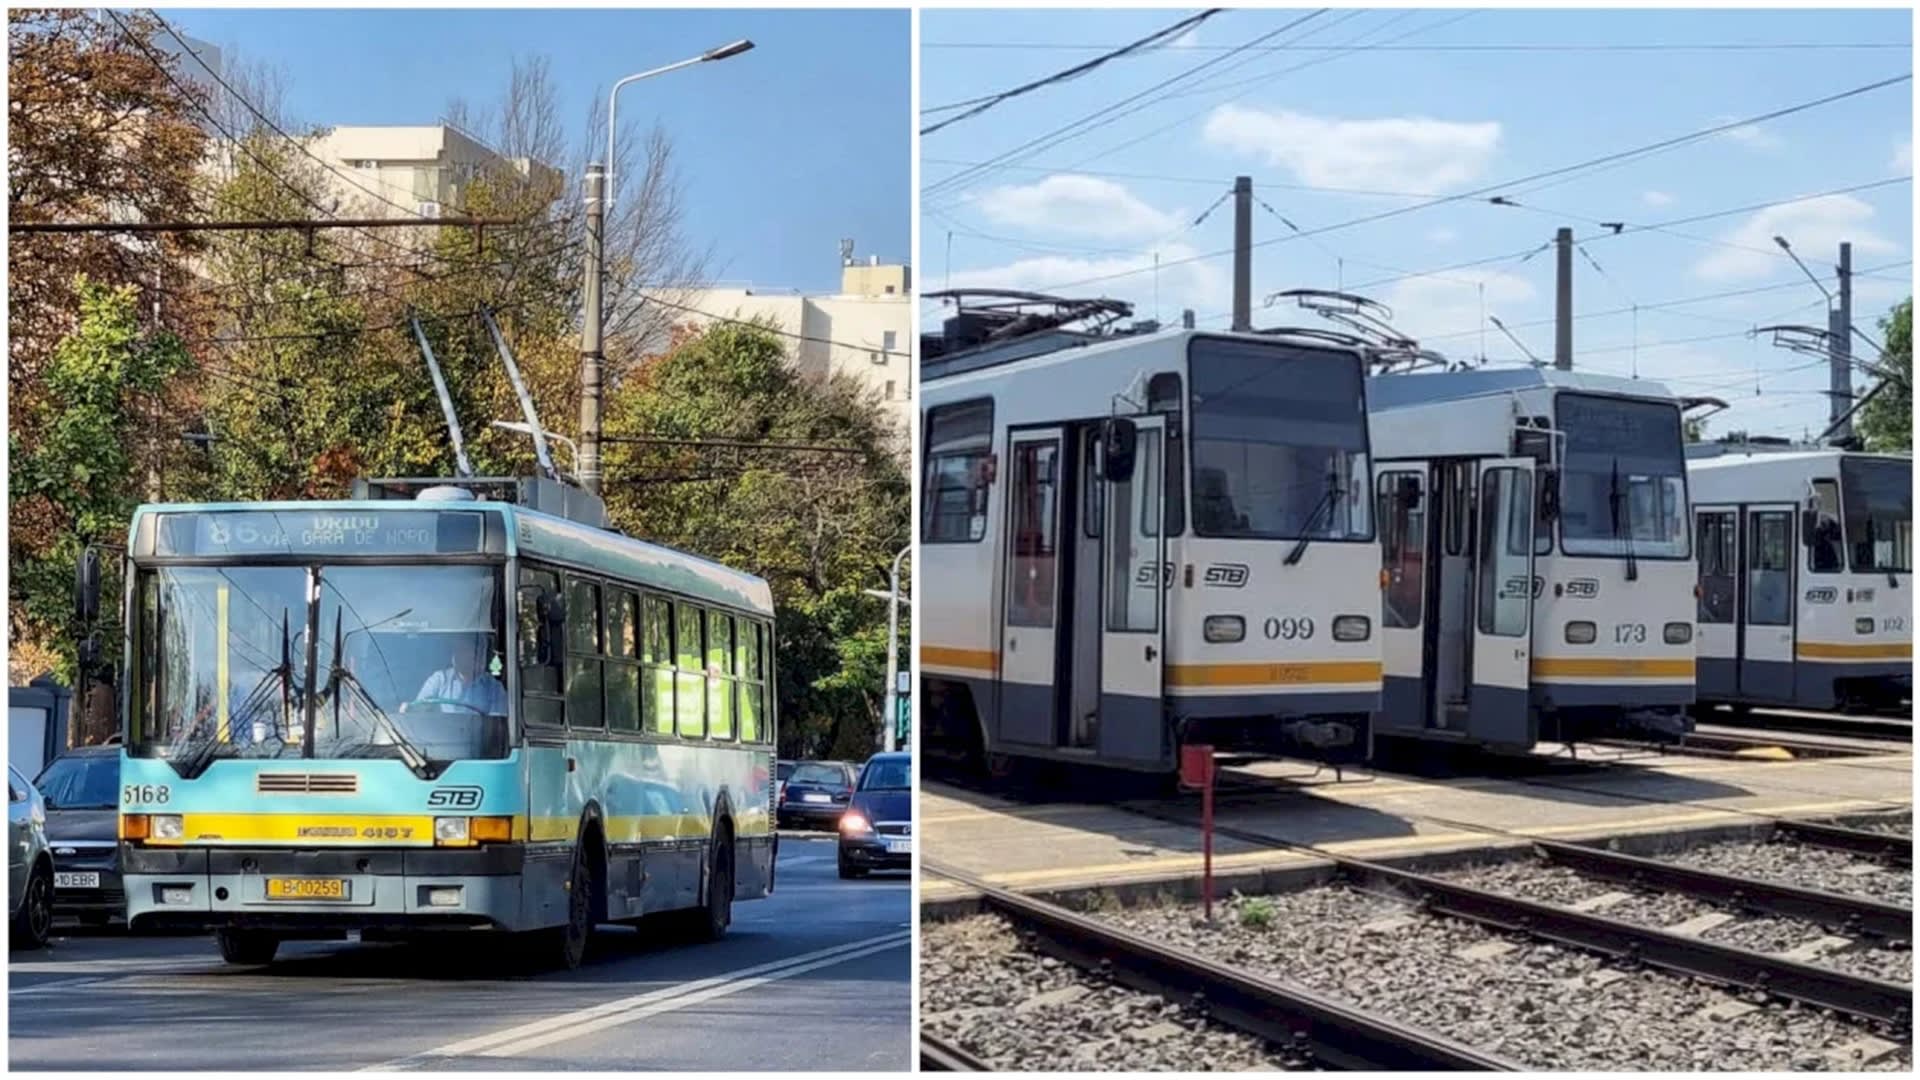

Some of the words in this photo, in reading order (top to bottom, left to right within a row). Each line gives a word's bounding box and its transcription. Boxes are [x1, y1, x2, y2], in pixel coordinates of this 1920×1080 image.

[209, 520, 257, 545] 86
[301, 529, 344, 545] GARA
[354, 529, 375, 545] DE
[1203, 567, 1244, 582] STB
[1264, 617, 1314, 640] 099
[1883, 618, 1903, 632] 102
[1615, 624, 1646, 643] 173
[124, 784, 169, 804] 5168
[428, 790, 478, 805] STB
[71, 874, 97, 886] EBR
